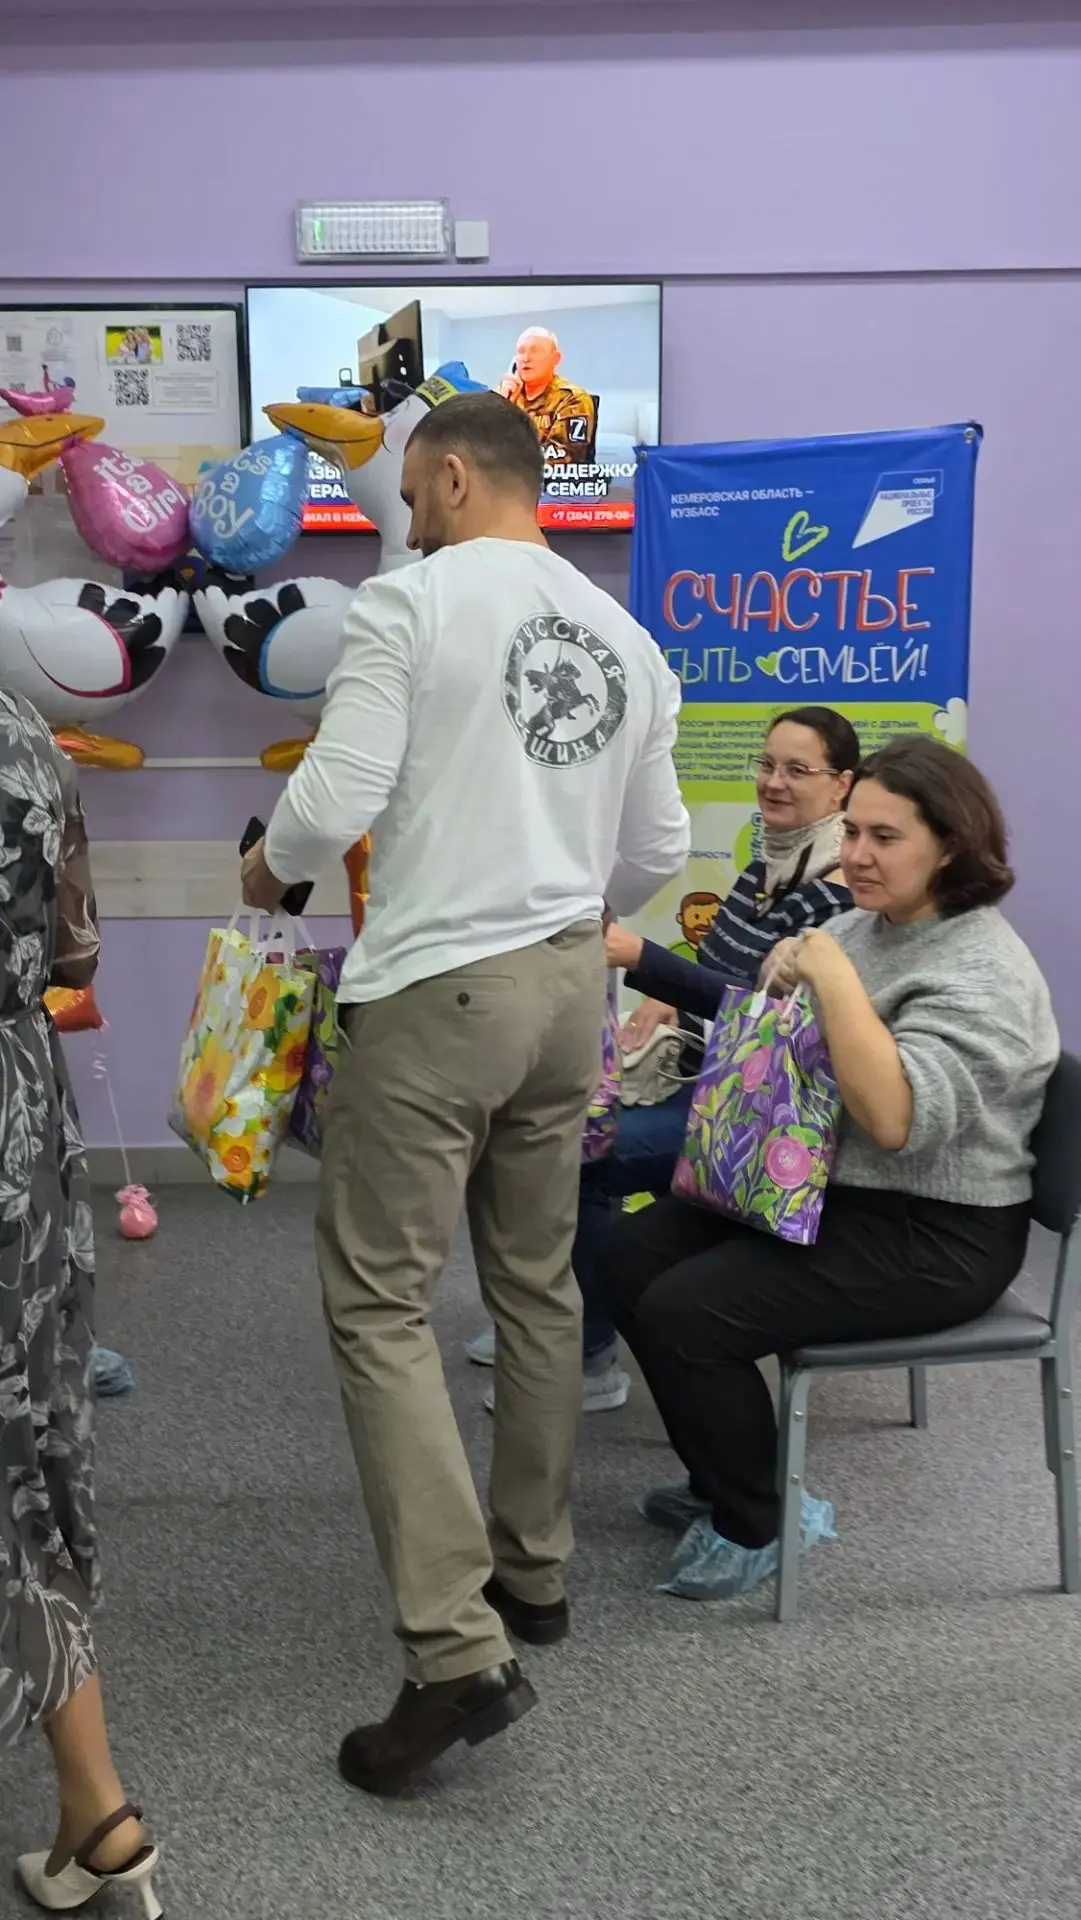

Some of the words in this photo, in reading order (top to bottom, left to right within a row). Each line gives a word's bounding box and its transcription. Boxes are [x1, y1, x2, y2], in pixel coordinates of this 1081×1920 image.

[224, 448, 273, 476] t's
[546, 479, 607, 496] СЕМЕЙ
[670, 490, 750, 505] КЕМЕРОВСКАЯ
[751, 487, 804, 501] ОБЛАСТЬ
[193, 479, 255, 540] Boy
[670, 506, 721, 519] КУЗБАСС
[663, 567, 935, 632] СЧАСТЬЕ
[514, 617, 626, 685] РУССКАЯ
